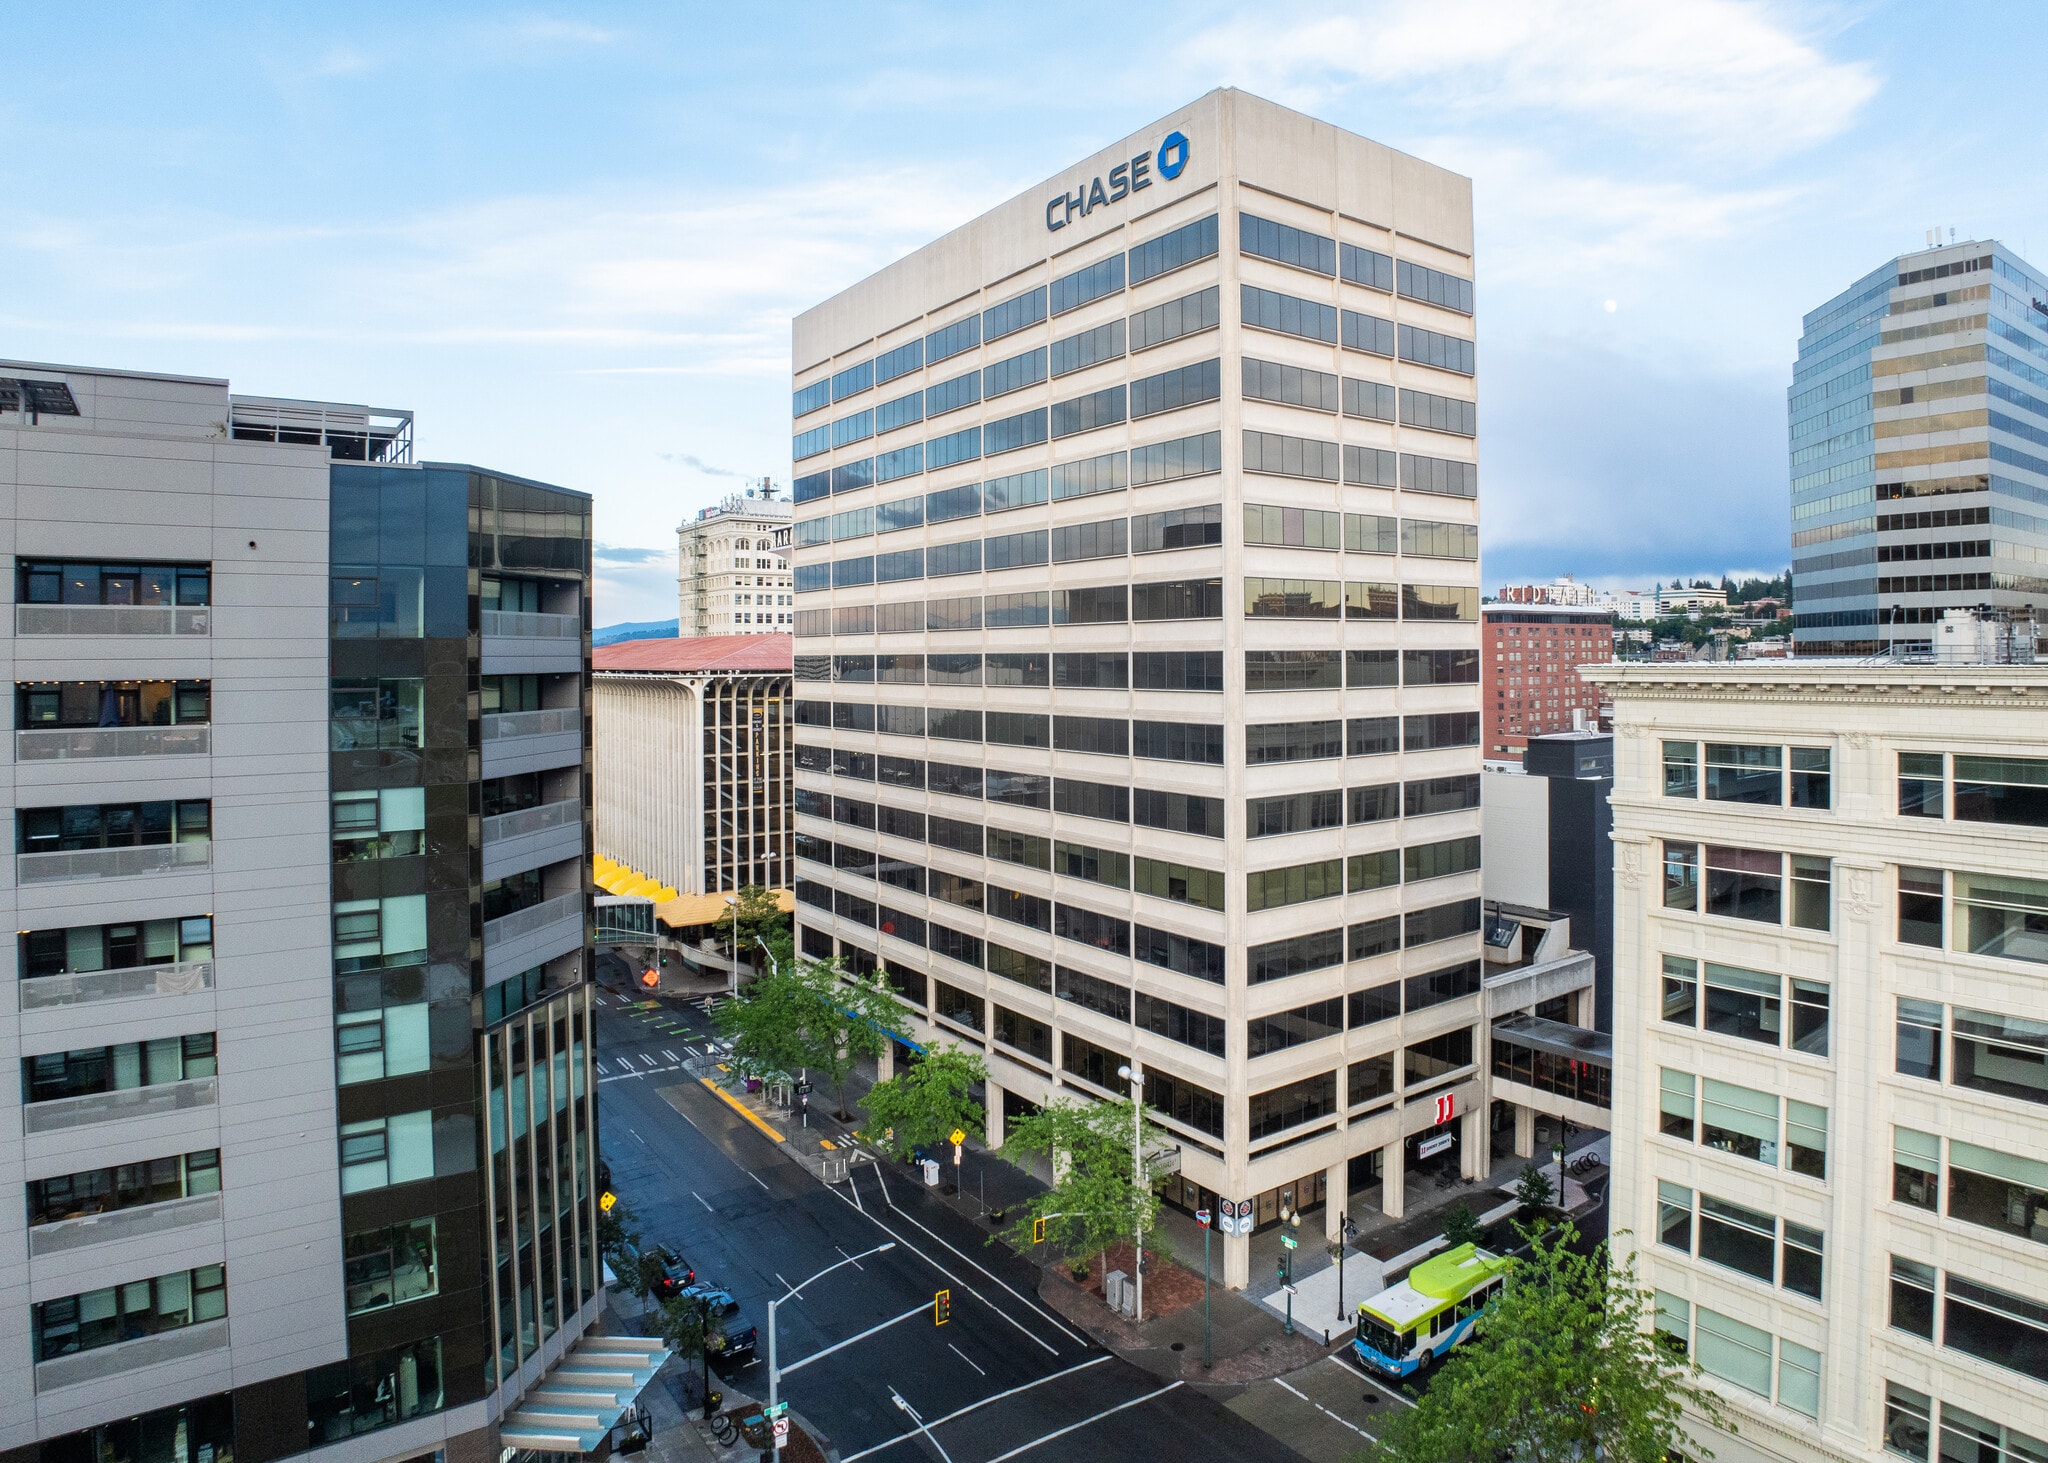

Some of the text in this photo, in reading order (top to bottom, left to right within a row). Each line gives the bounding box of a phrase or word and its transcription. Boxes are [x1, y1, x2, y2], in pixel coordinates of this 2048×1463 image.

[1046, 150, 1152, 232] CHASE
[1506, 584, 1595, 606] RIDPATH
[1435, 1093, 1455, 1125] JJ
